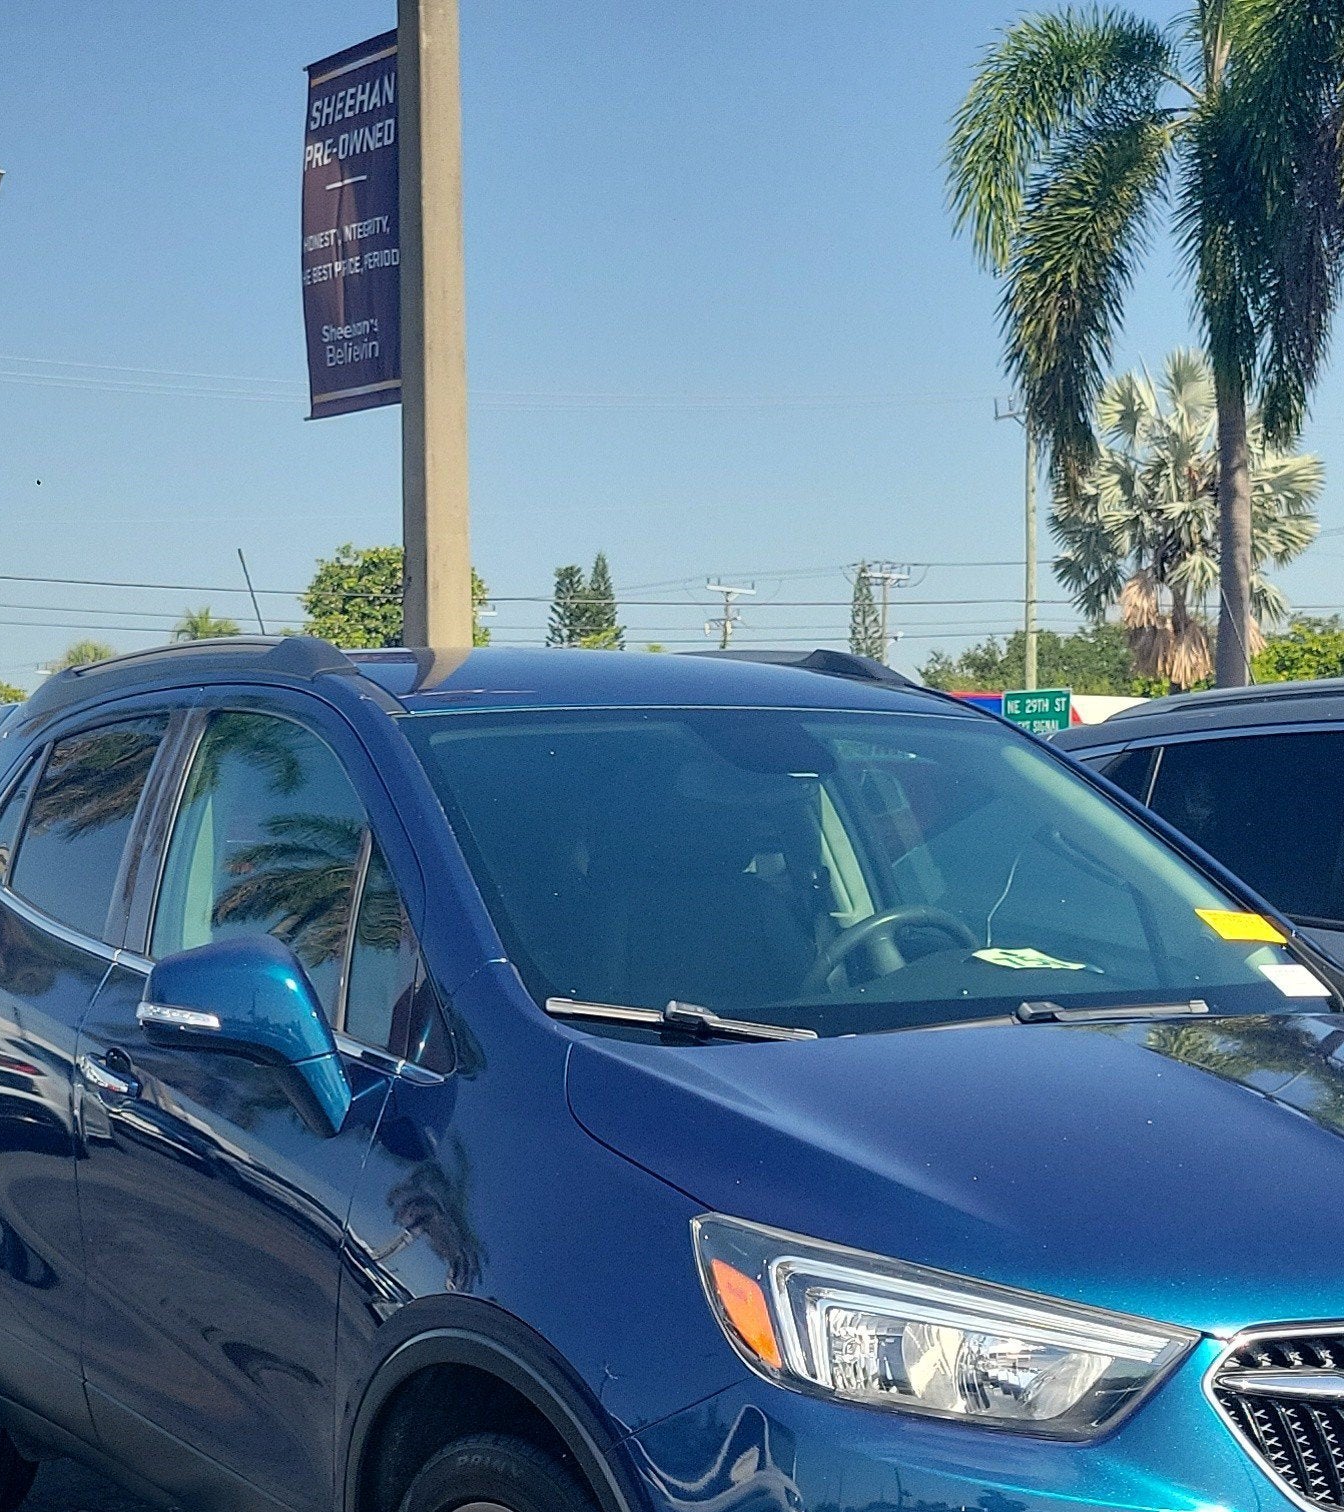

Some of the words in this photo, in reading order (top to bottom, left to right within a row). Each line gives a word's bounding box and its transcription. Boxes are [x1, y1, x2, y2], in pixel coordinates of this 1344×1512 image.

[310, 72, 396, 131] SHEEHAN
[304, 118, 396, 172] PRE-OWNED
[1007, 700, 1022, 714] NE
[1025, 698, 1050, 714] 29TH
[1054, 697, 1067, 712] ST
